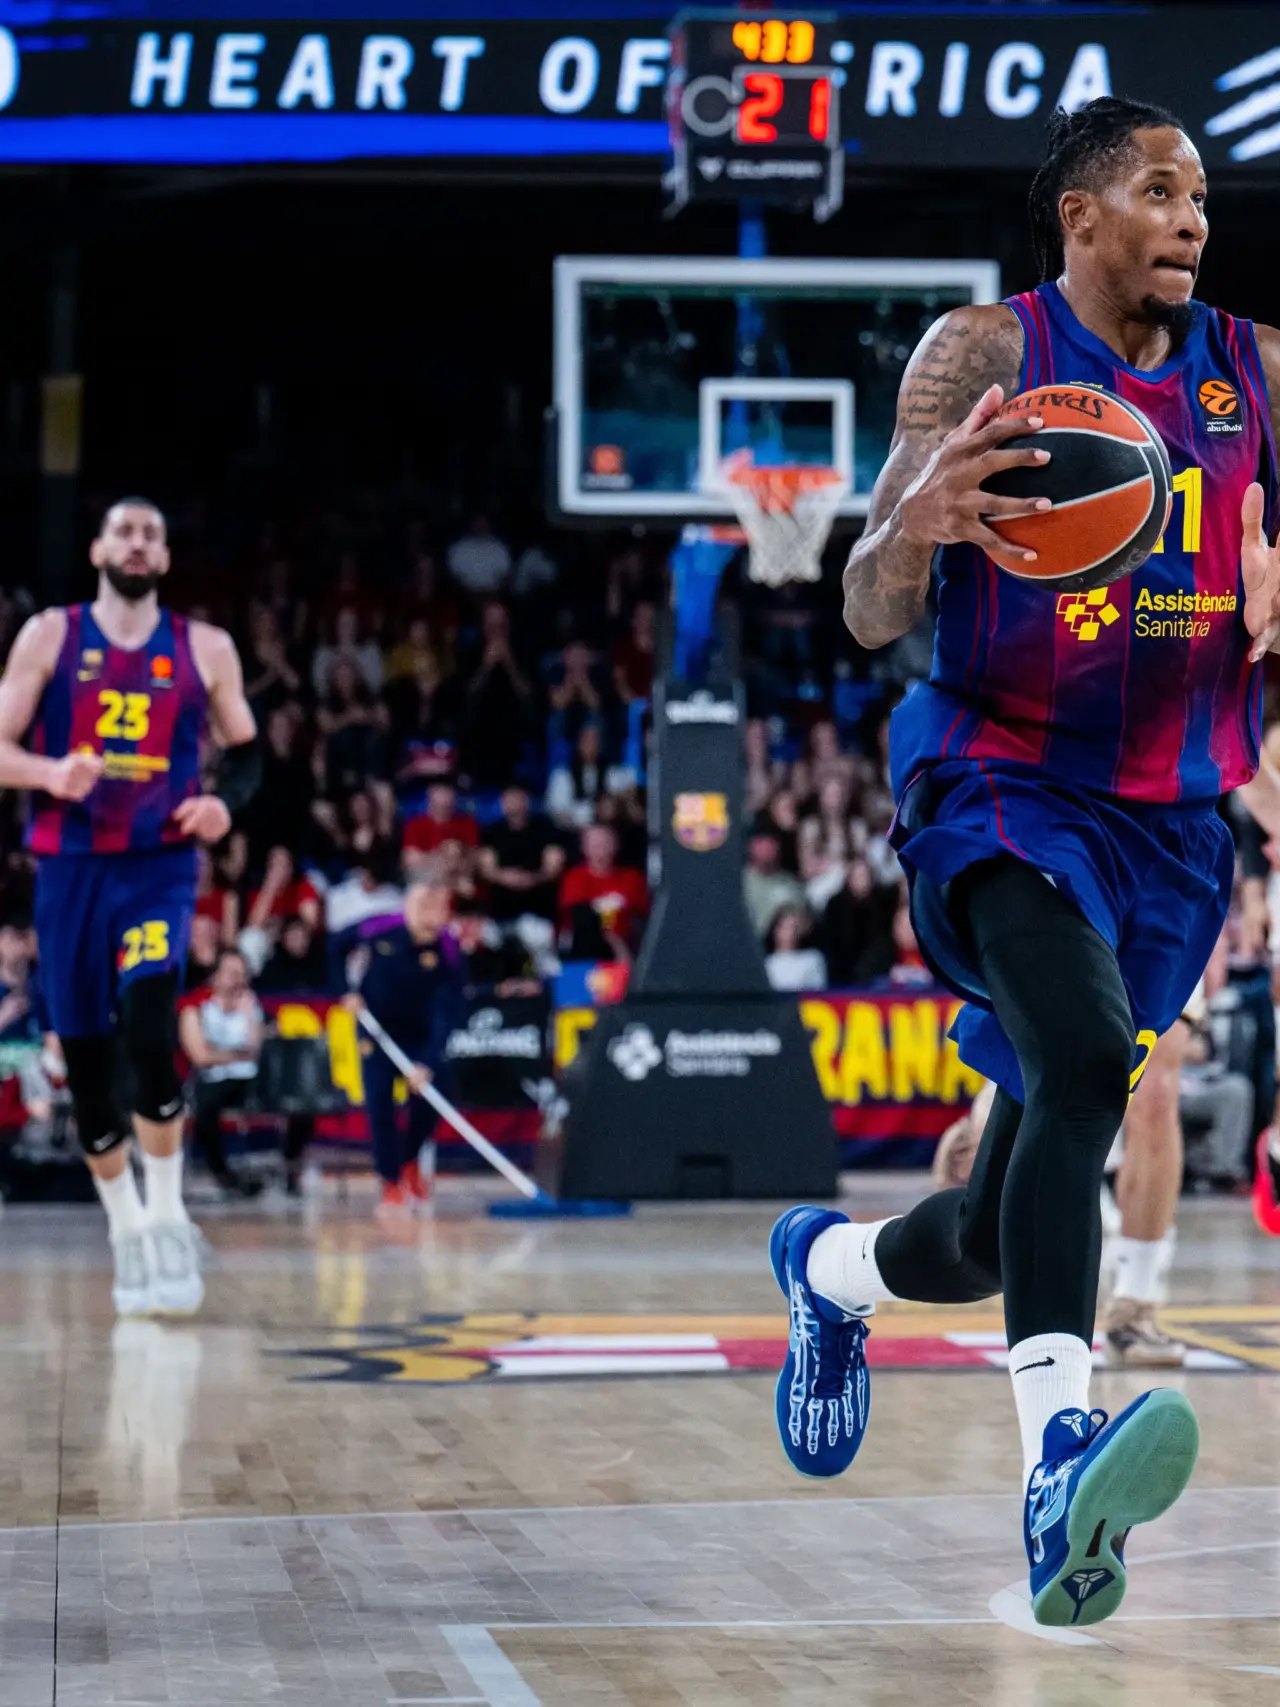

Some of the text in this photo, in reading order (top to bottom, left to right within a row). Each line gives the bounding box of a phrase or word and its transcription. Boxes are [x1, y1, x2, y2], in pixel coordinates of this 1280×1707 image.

[130, 32, 1113, 118] HEART OF RICA
[738, 72, 831, 143] 21
[1152, 467, 1202, 553] 1
[1134, 588, 1237, 612] Assistència
[1134, 613, 1211, 638] Sanitària
[95, 689, 151, 741] 23
[121, 920, 169, 971] 23
